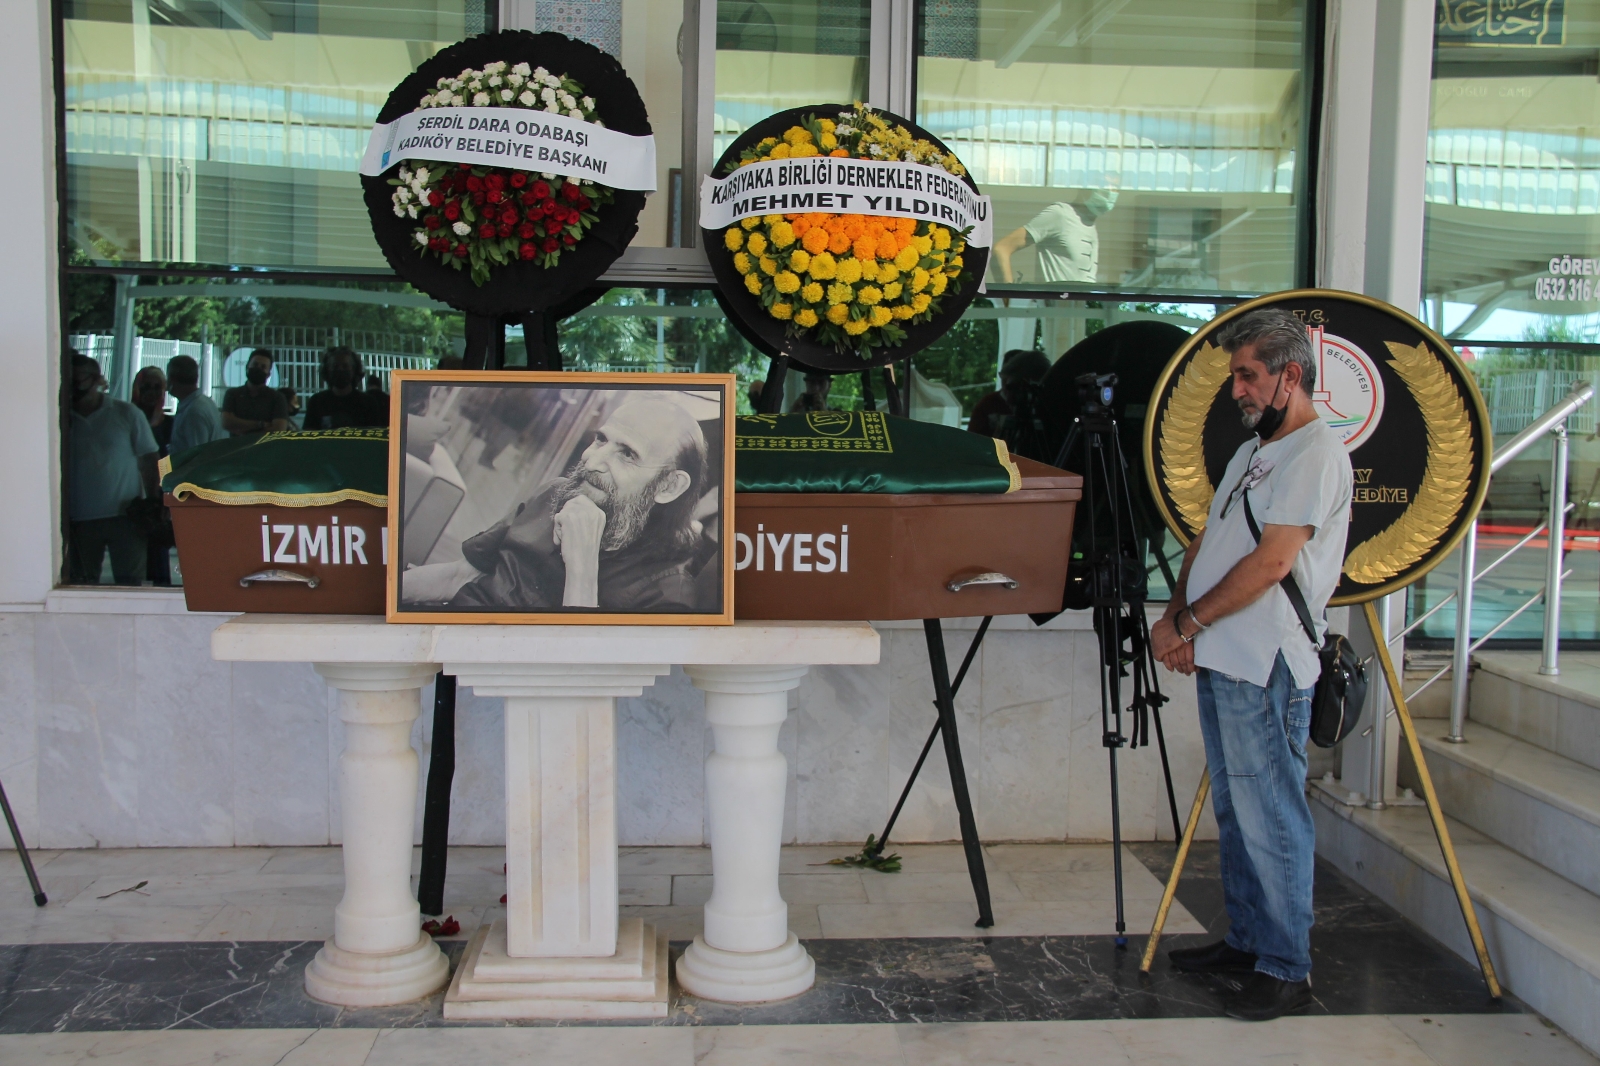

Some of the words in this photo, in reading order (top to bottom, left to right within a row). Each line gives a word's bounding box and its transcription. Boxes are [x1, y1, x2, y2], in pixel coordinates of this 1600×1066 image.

[468, 117, 510, 134] DARA
[516, 121, 588, 147] ODABAŞI
[397, 134, 454, 152] KADIKÖY
[456, 137, 533, 160] BELEDİYE
[538, 146, 608, 175] BAŞKANI
[711, 167, 774, 205] KARŞIYAKA
[779, 159, 832, 186] BİRLİĞİ
[837, 164, 923, 192] DERNEKLER
[926, 173, 988, 222] FEDERASYNU
[732, 192, 854, 217] MEHMET
[864, 195, 968, 230] YILDIRIM
[1535, 277, 1566, 301] 0532
[1567, 278, 1592, 302] 316
[1292, 309, 1330, 322] T.C.
[261, 514, 369, 565] İZMİR
[734, 523, 849, 573] DİYESİ
